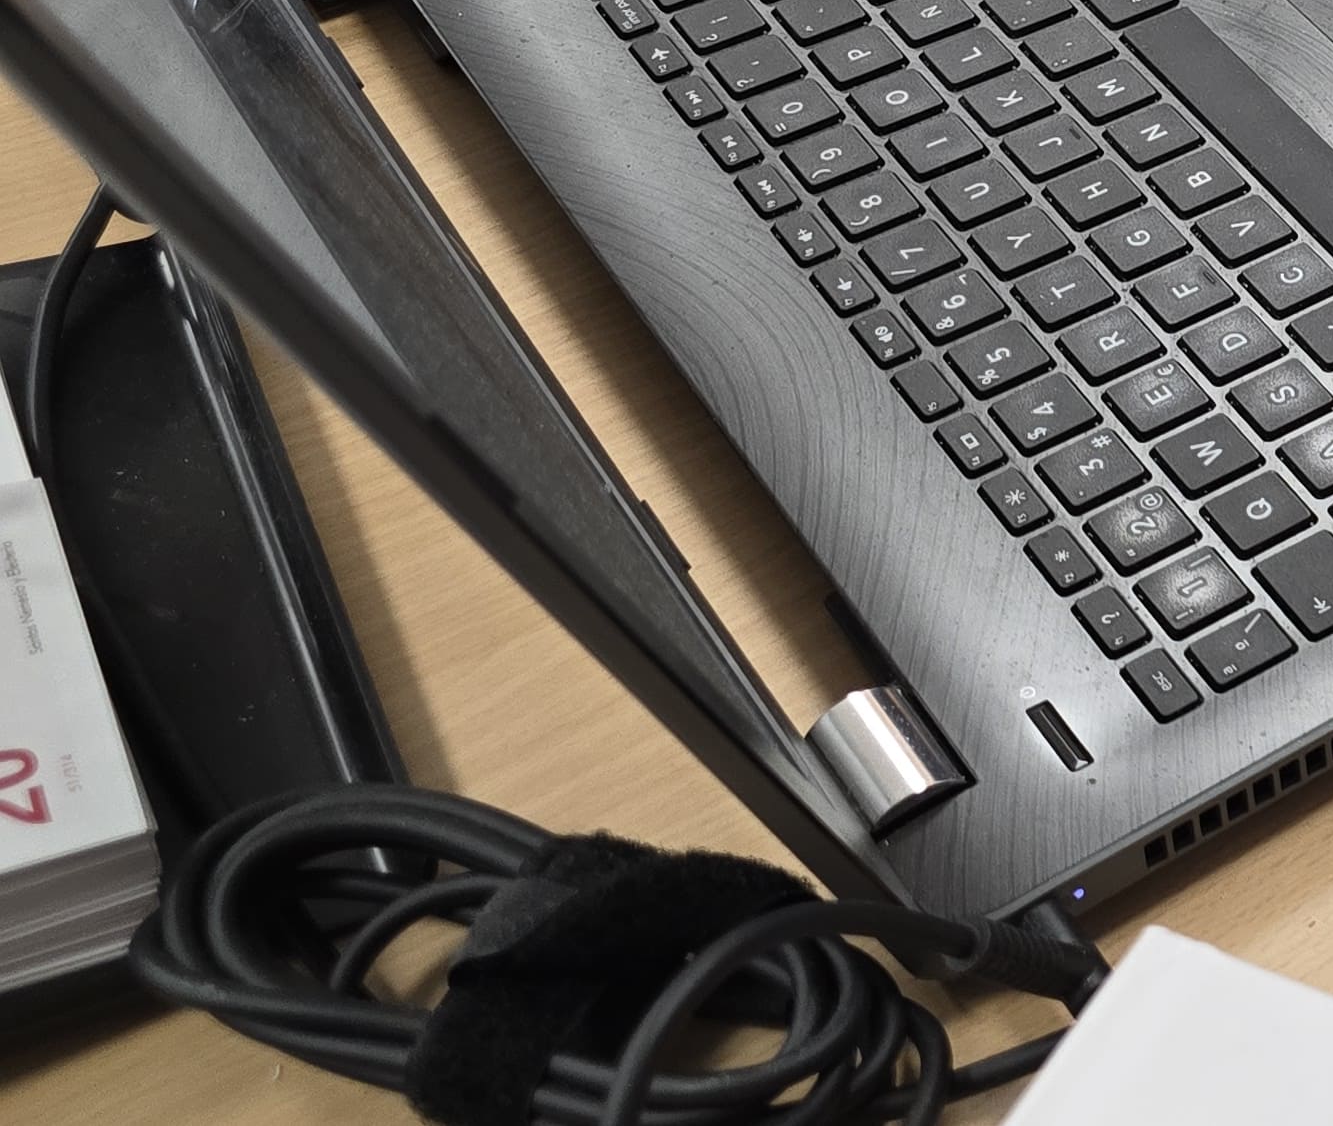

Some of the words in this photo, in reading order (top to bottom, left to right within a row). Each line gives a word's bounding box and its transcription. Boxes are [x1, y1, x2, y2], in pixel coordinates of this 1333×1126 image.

[848, 49, 871, 61] P
[961, 47, 982, 62] L
[1097, 79, 1125, 97] M
[996, 90, 1023, 107] K
[1140, 124, 1168, 142] N
[1038, 137, 1063, 147] J
[1187, 171, 1213, 189] B
[964, 183, 990, 200] U
[1080, 181, 1108, 200] H
[860, 195, 882, 209] 8
[1230, 220, 1256, 237] V
[1006, 232, 1032, 249] Y
[1126, 229, 1151, 247] G
[1280, 267, 1304, 284] C
[1051, 282, 1076, 299] T
[1171, 283, 1200, 299] F
[1099, 331, 1126, 352] R
[1222, 332, 1248, 352] D
[986, 347, 1011, 362] 5
[1144, 384, 1173, 405] E
[1270, 385, 1296, 404] S
[1189, 440, 1223, 466] W
[1246, 497, 1272, 520] Q
[1130, 515, 1158, 534] 2
